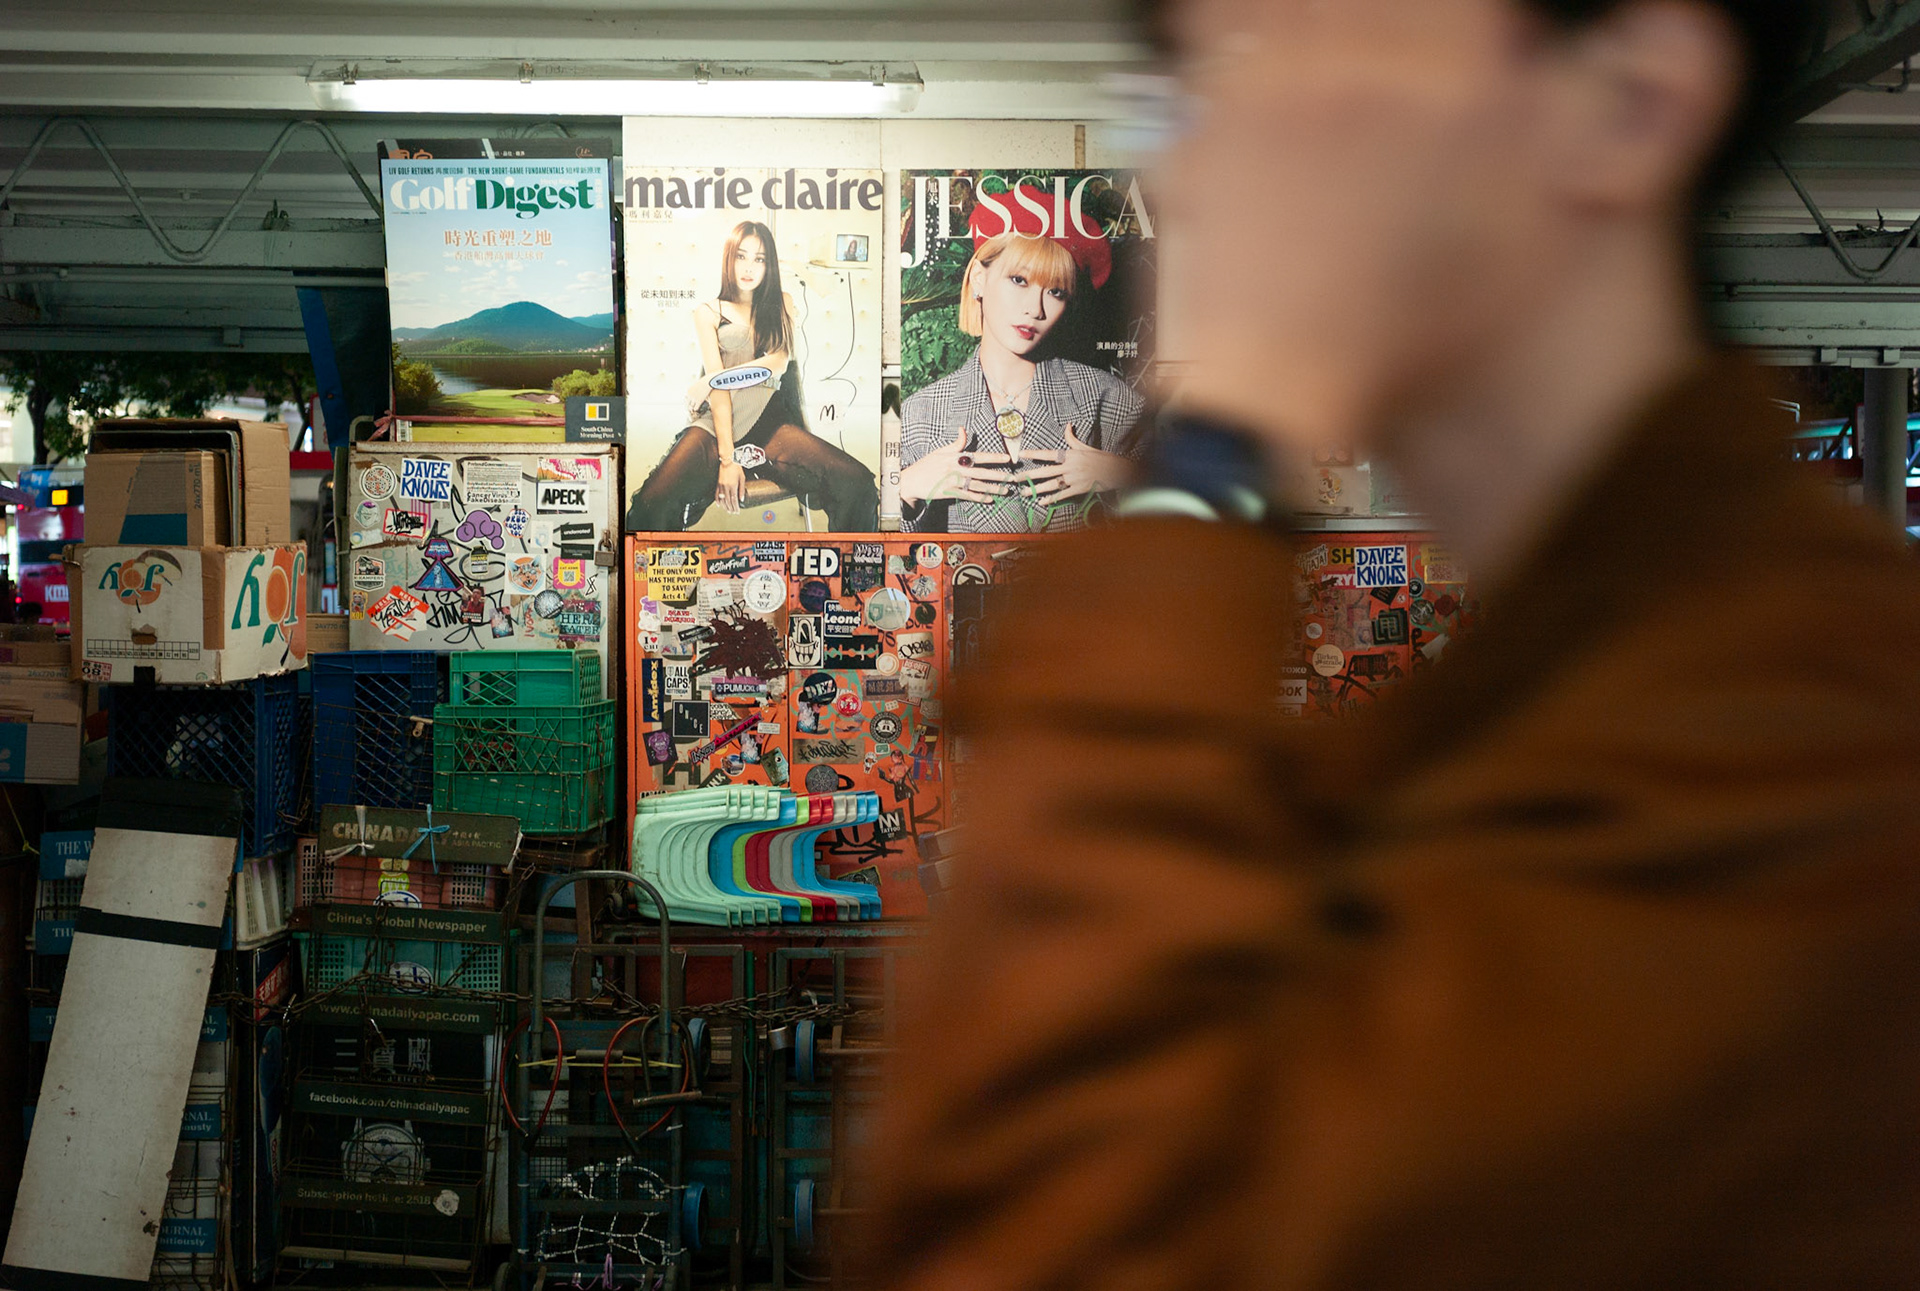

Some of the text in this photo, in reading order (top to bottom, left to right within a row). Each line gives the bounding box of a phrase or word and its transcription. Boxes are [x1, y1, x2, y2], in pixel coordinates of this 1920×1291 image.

[411, 167, 434, 175] RETURNS
[467, 167, 478, 175] THE
[479, 167, 490, 175] NEW
[390, 177, 476, 211] Golf
[475, 176, 594, 220] Digest
[625, 168, 753, 209] marie
[761, 168, 884, 211] claire
[900, 174, 1157, 269] JESSICA
[443, 229, 553, 247] 時光重塑之地
[640, 289, 697, 299] 從未知到未來
[715, 370, 768, 386] SEDURRE
[403, 459, 450, 480] DAVEE
[401, 477, 451, 500] KNOWS
[542, 488, 585, 505] APECK
[1356, 547, 1405, 566] DAVEE
[649, 576, 661, 584] HAS
[652, 568, 664, 576] THE
[1357, 565, 1406, 586] KNOWS
[824, 613, 861, 625] Leone
[675, 667, 688, 677] ALL
[332, 822, 394, 842] CHNA
[56, 842, 81, 857] THE
[327, 912, 372, 925] China's
[418, 917, 487, 933] Newspaper
[320, 1004, 481, 1024] www.cinadailyapac.com
[309, 1091, 471, 1114] facebook.com/chinadailyapac
